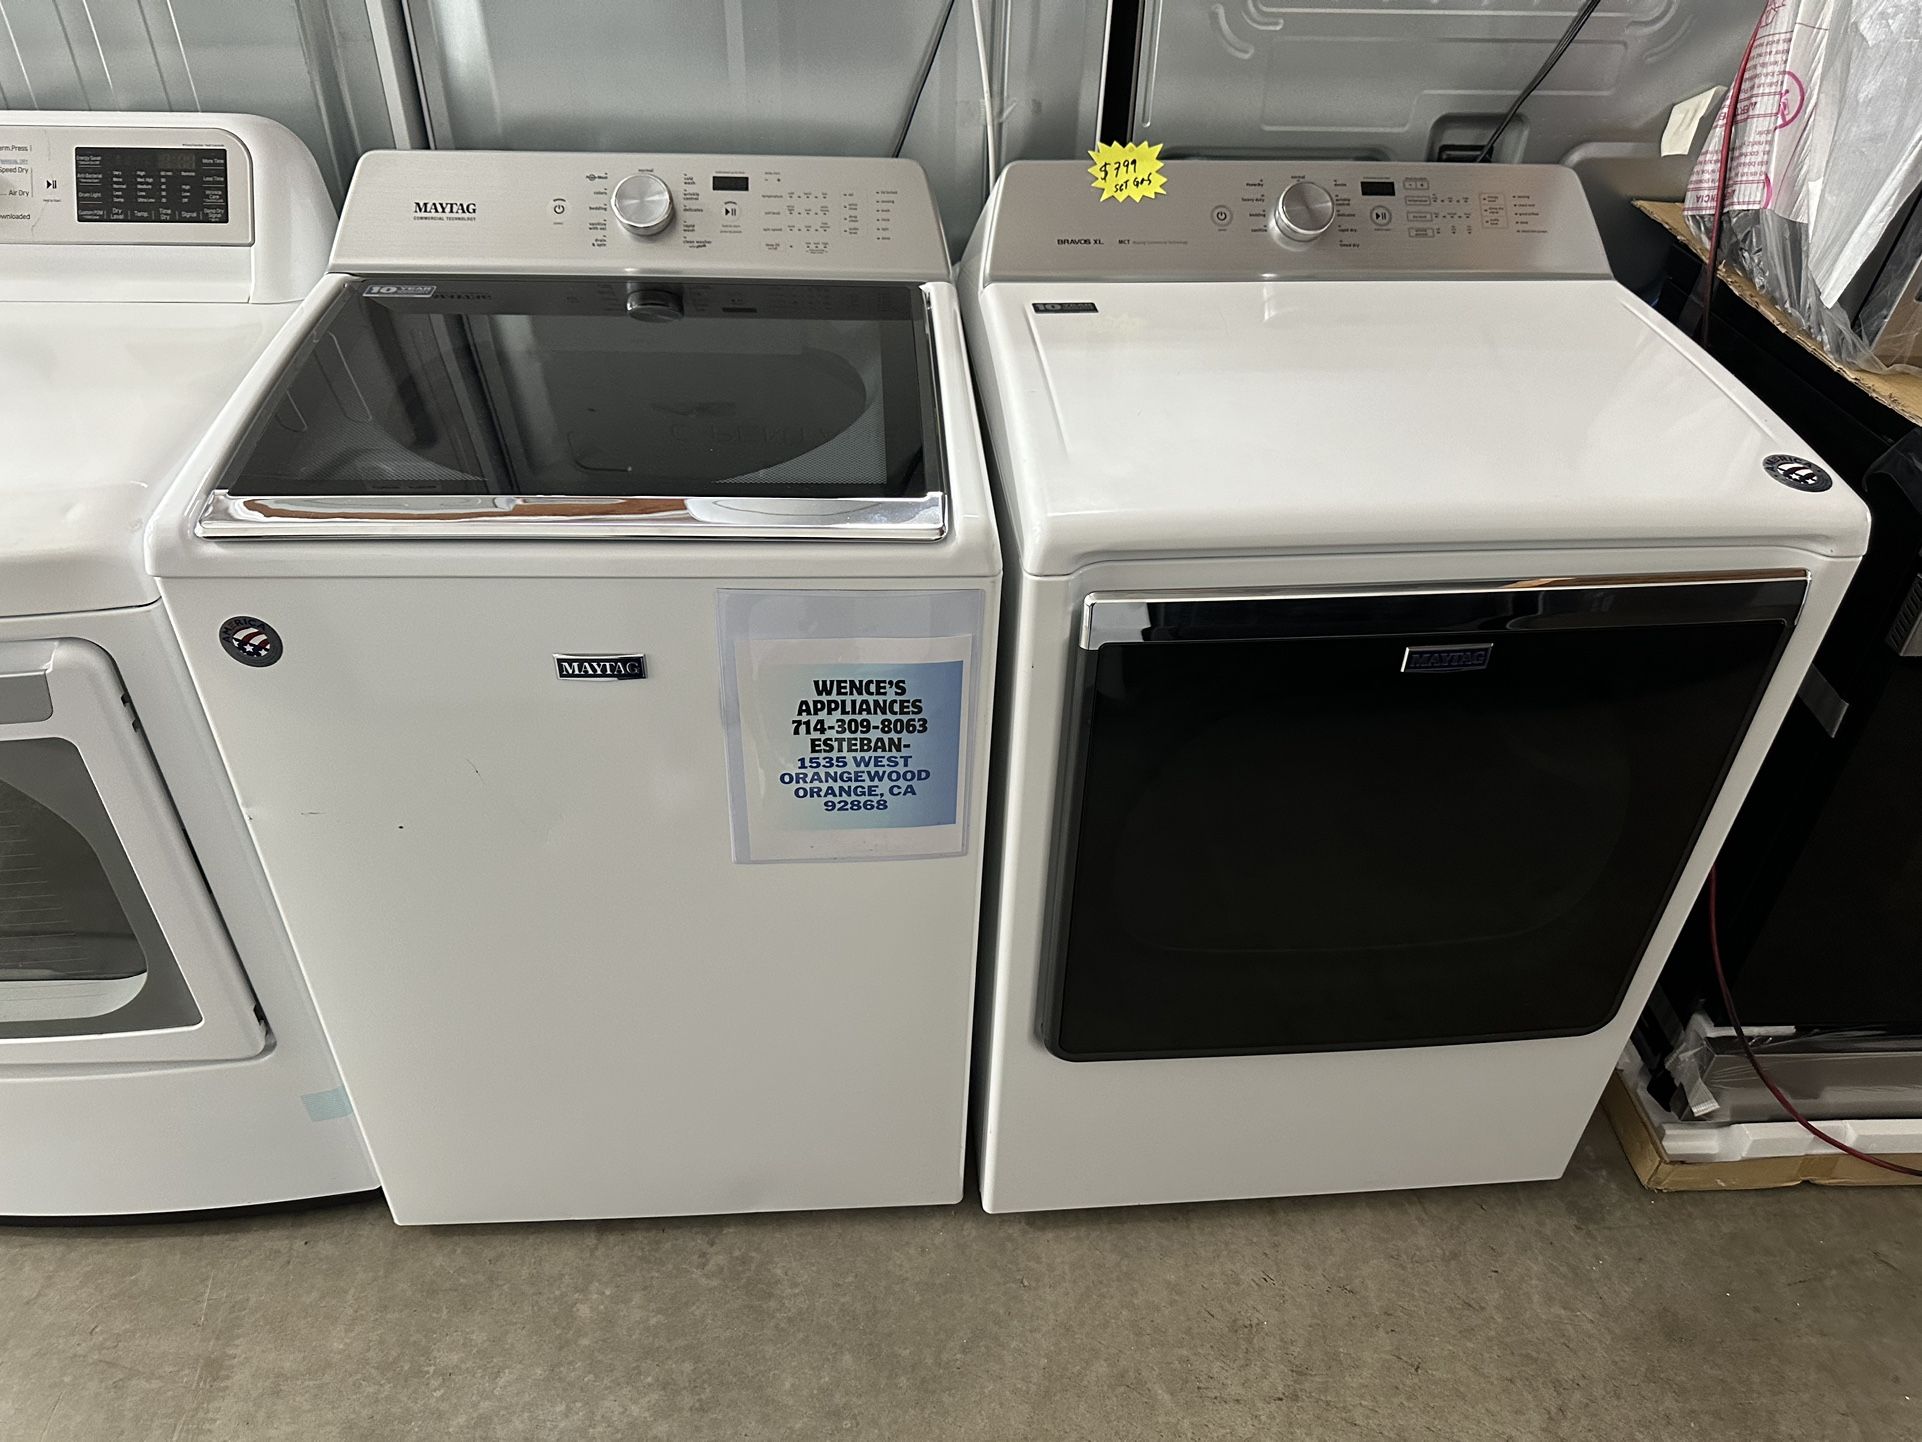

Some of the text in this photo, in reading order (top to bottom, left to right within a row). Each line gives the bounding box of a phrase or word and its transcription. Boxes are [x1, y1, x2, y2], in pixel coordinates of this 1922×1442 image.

[414, 202, 476, 214] MAYTAG
[1409, 651, 1486, 666] MAYTAG
[560, 662, 640, 675] MAYTAG
[813, 680, 906, 696] WENCE'S
[796, 699, 923, 716] APPLIANCES
[792, 718, 928, 736] 714-309-8063
[810, 737, 911, 753] ESTEBAN-
[797, 756, 912, 769] 1535 WEST
[780, 769, 931, 784] ORANGEWOOD
[794, 784, 917, 798] ORANGE, CA
[823, 800, 888, 812] 92868
